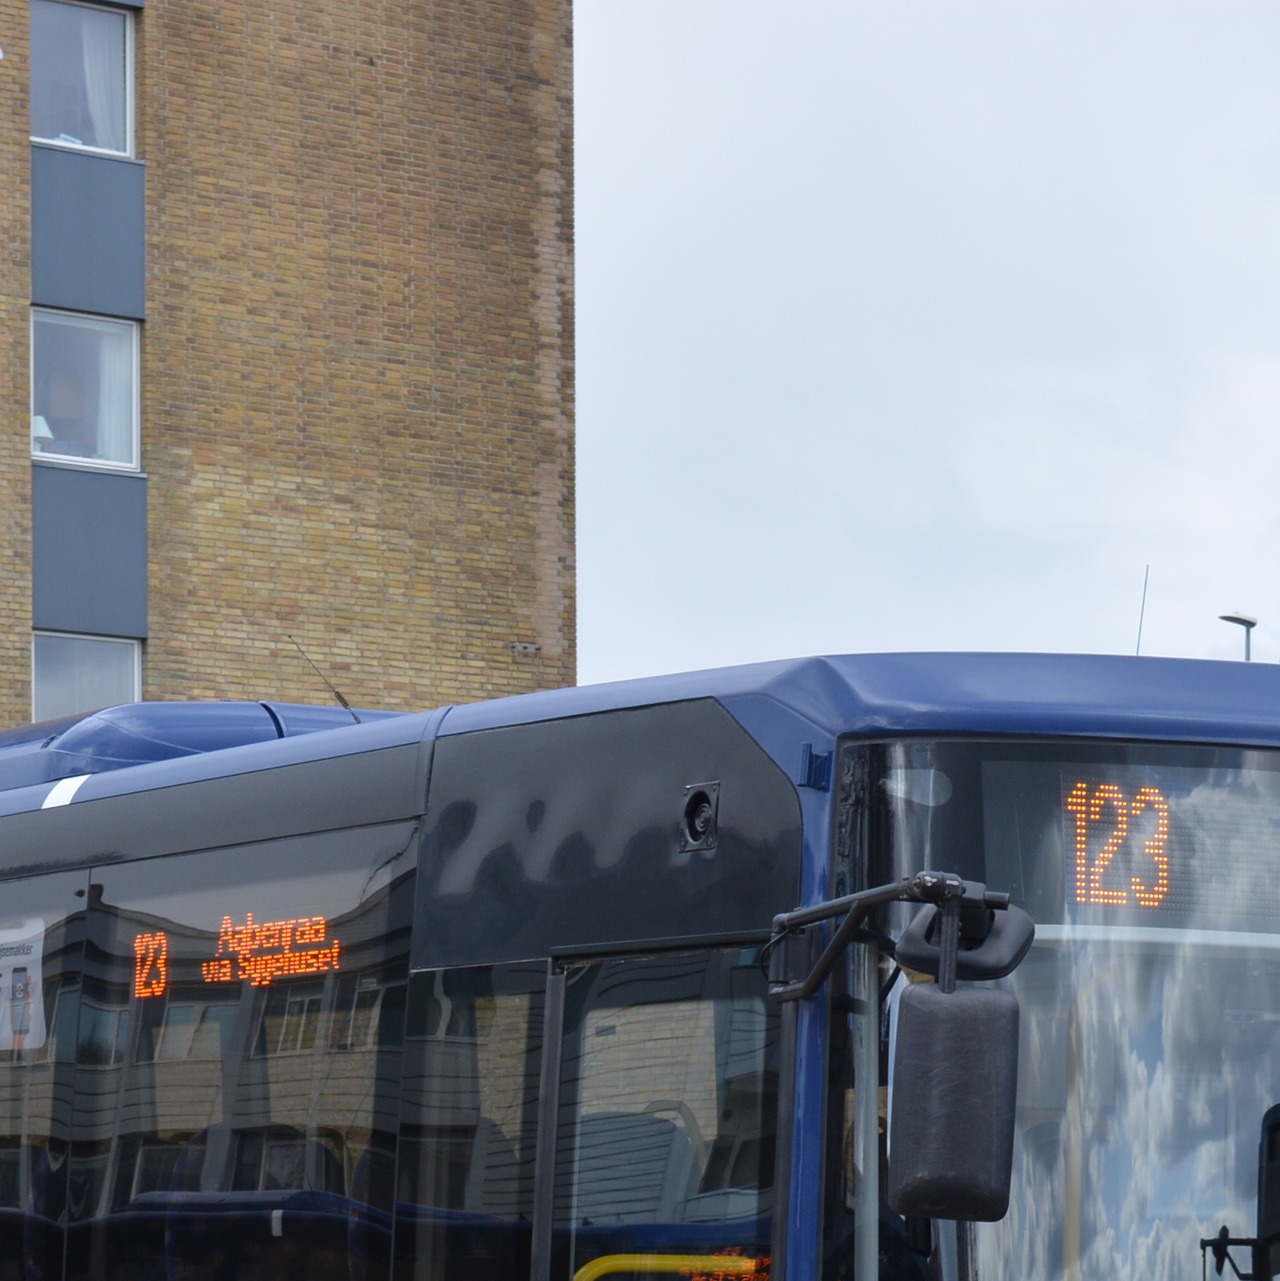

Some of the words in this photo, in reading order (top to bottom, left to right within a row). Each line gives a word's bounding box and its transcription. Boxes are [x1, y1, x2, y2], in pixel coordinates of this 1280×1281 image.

[1067, 782, 1168, 907] 123
[215, 912, 327, 957] Aabenraa
[134, 931, 167, 998] 123
[202, 960, 232, 982] via
[238, 940, 340, 986] Sygehuset
